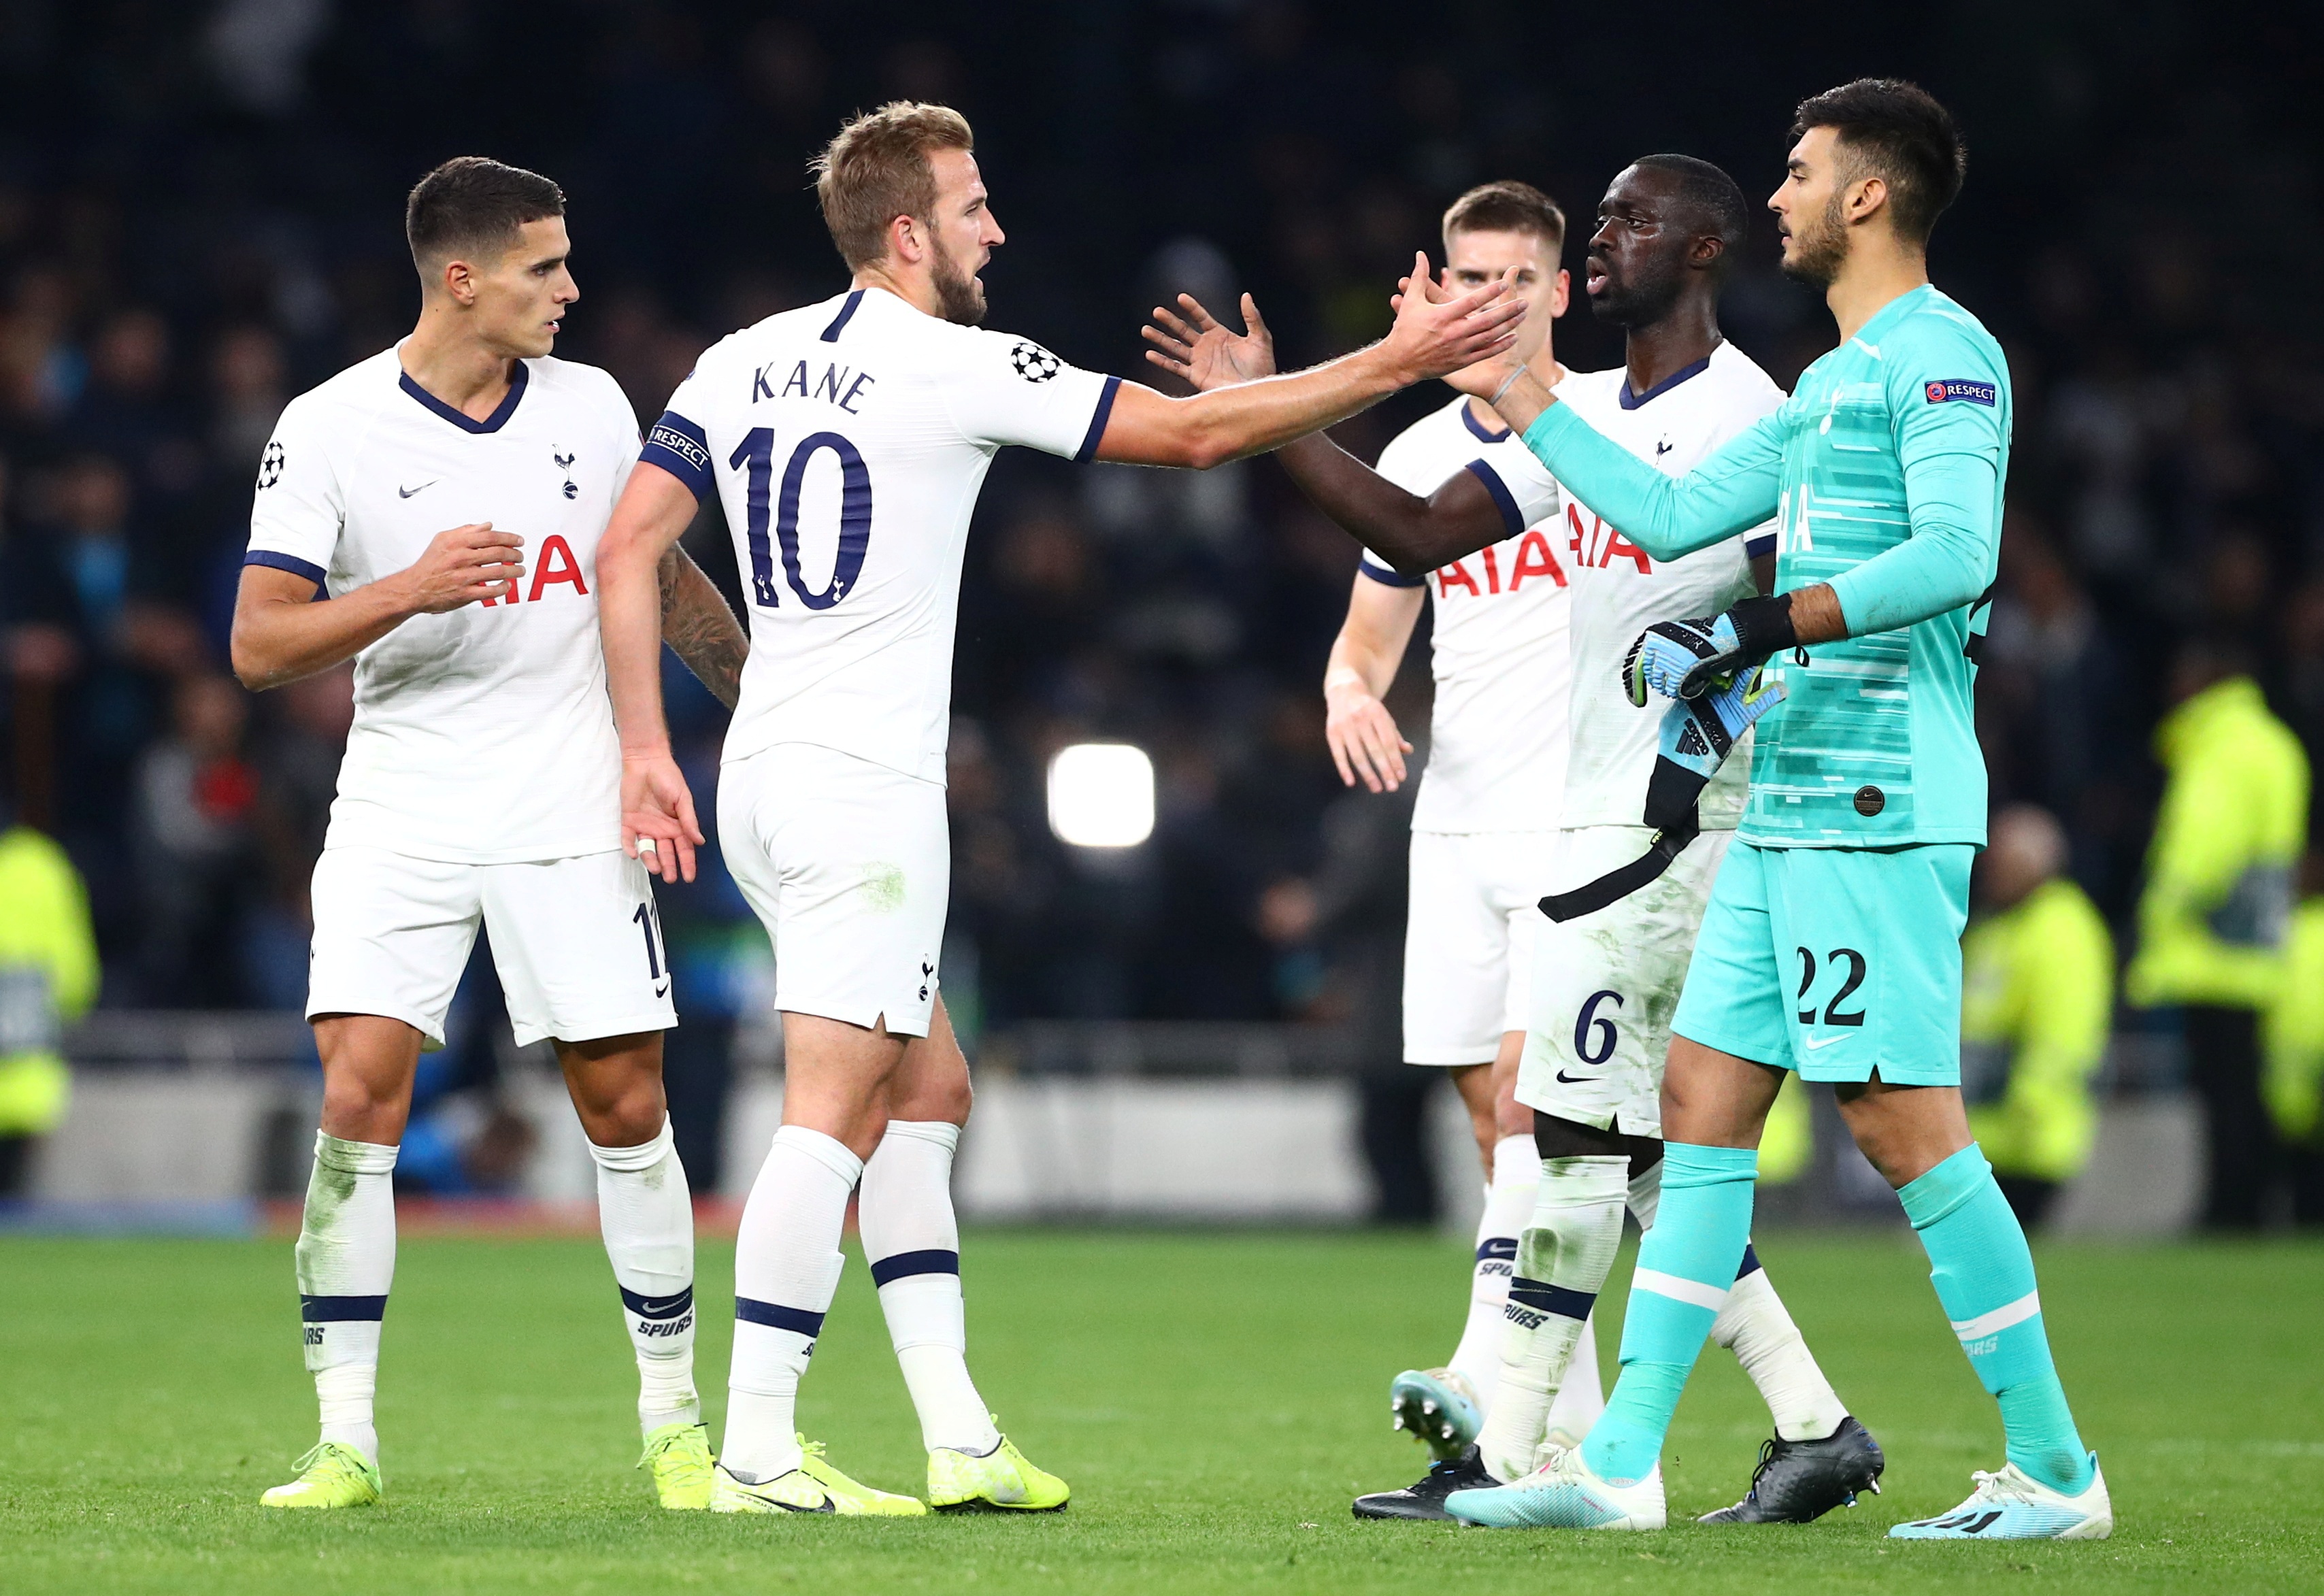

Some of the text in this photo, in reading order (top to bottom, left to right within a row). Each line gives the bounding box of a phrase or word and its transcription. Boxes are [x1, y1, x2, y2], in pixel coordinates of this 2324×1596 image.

[752, 359, 876, 415] KANE
[1946, 384, 1995, 401] RESPECT
[654, 429, 708, 466] RESPECT
[729, 427, 872, 611] 10
[477, 535, 590, 608] IA
[1797, 946, 1867, 1027] 22
[1574, 990, 1625, 1065] 6
[637, 1308, 693, 1337] SPURS
